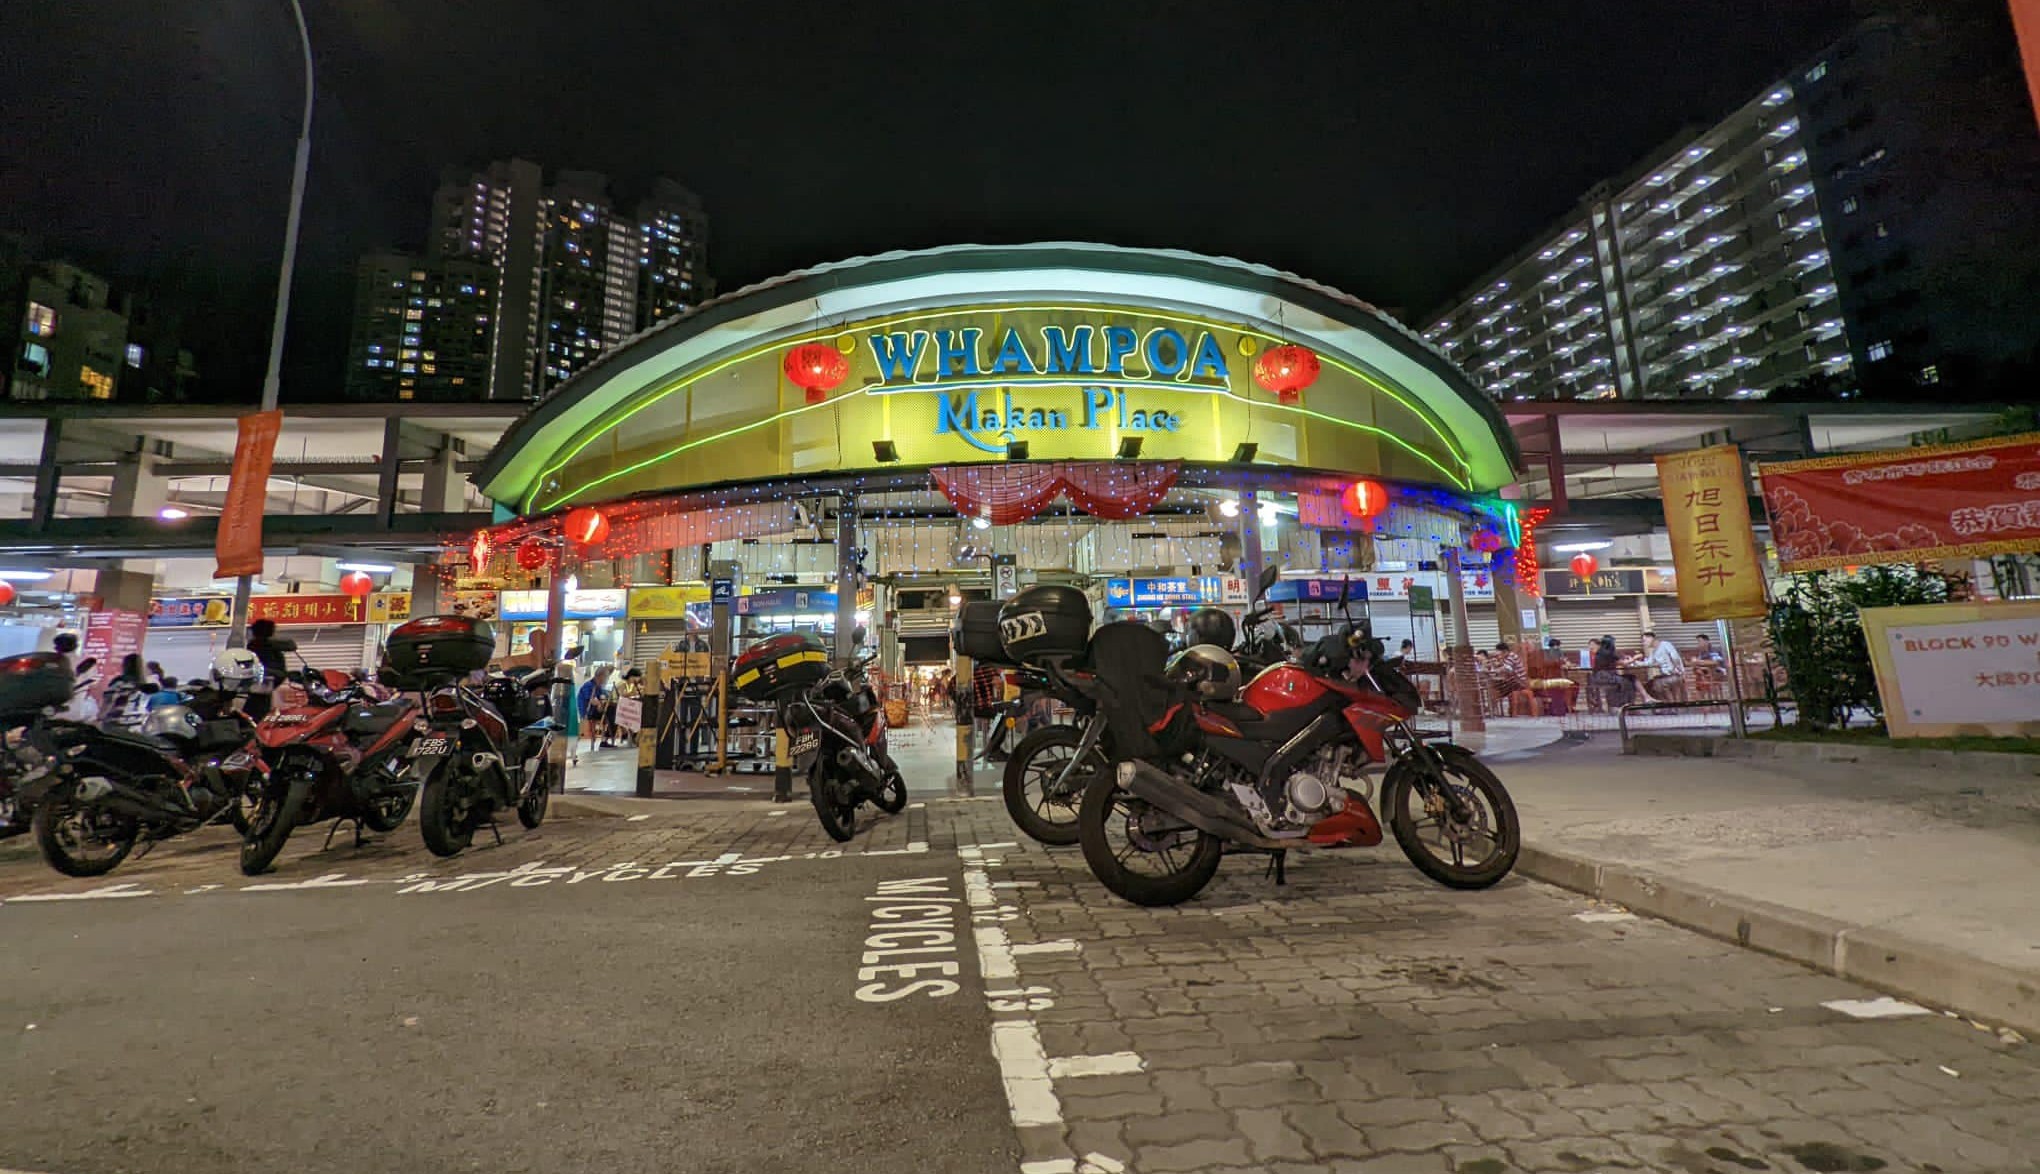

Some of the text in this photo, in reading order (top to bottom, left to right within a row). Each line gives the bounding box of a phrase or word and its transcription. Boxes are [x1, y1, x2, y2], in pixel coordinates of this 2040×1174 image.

[869, 326, 1230, 381] WHAMPOA
[935, 387, 1181, 452] Makan Place
[1685, 488, 1736, 587] 旭日东升
[1146, 581, 1187, 593] 中和茶室
[1904, 637, 1976, 652] BLOCK
[1983, 634, 2010, 648] 90
[396, 863, 766, 894] M/CYCLES
[855, 877, 961, 1003] M/CYCLES
